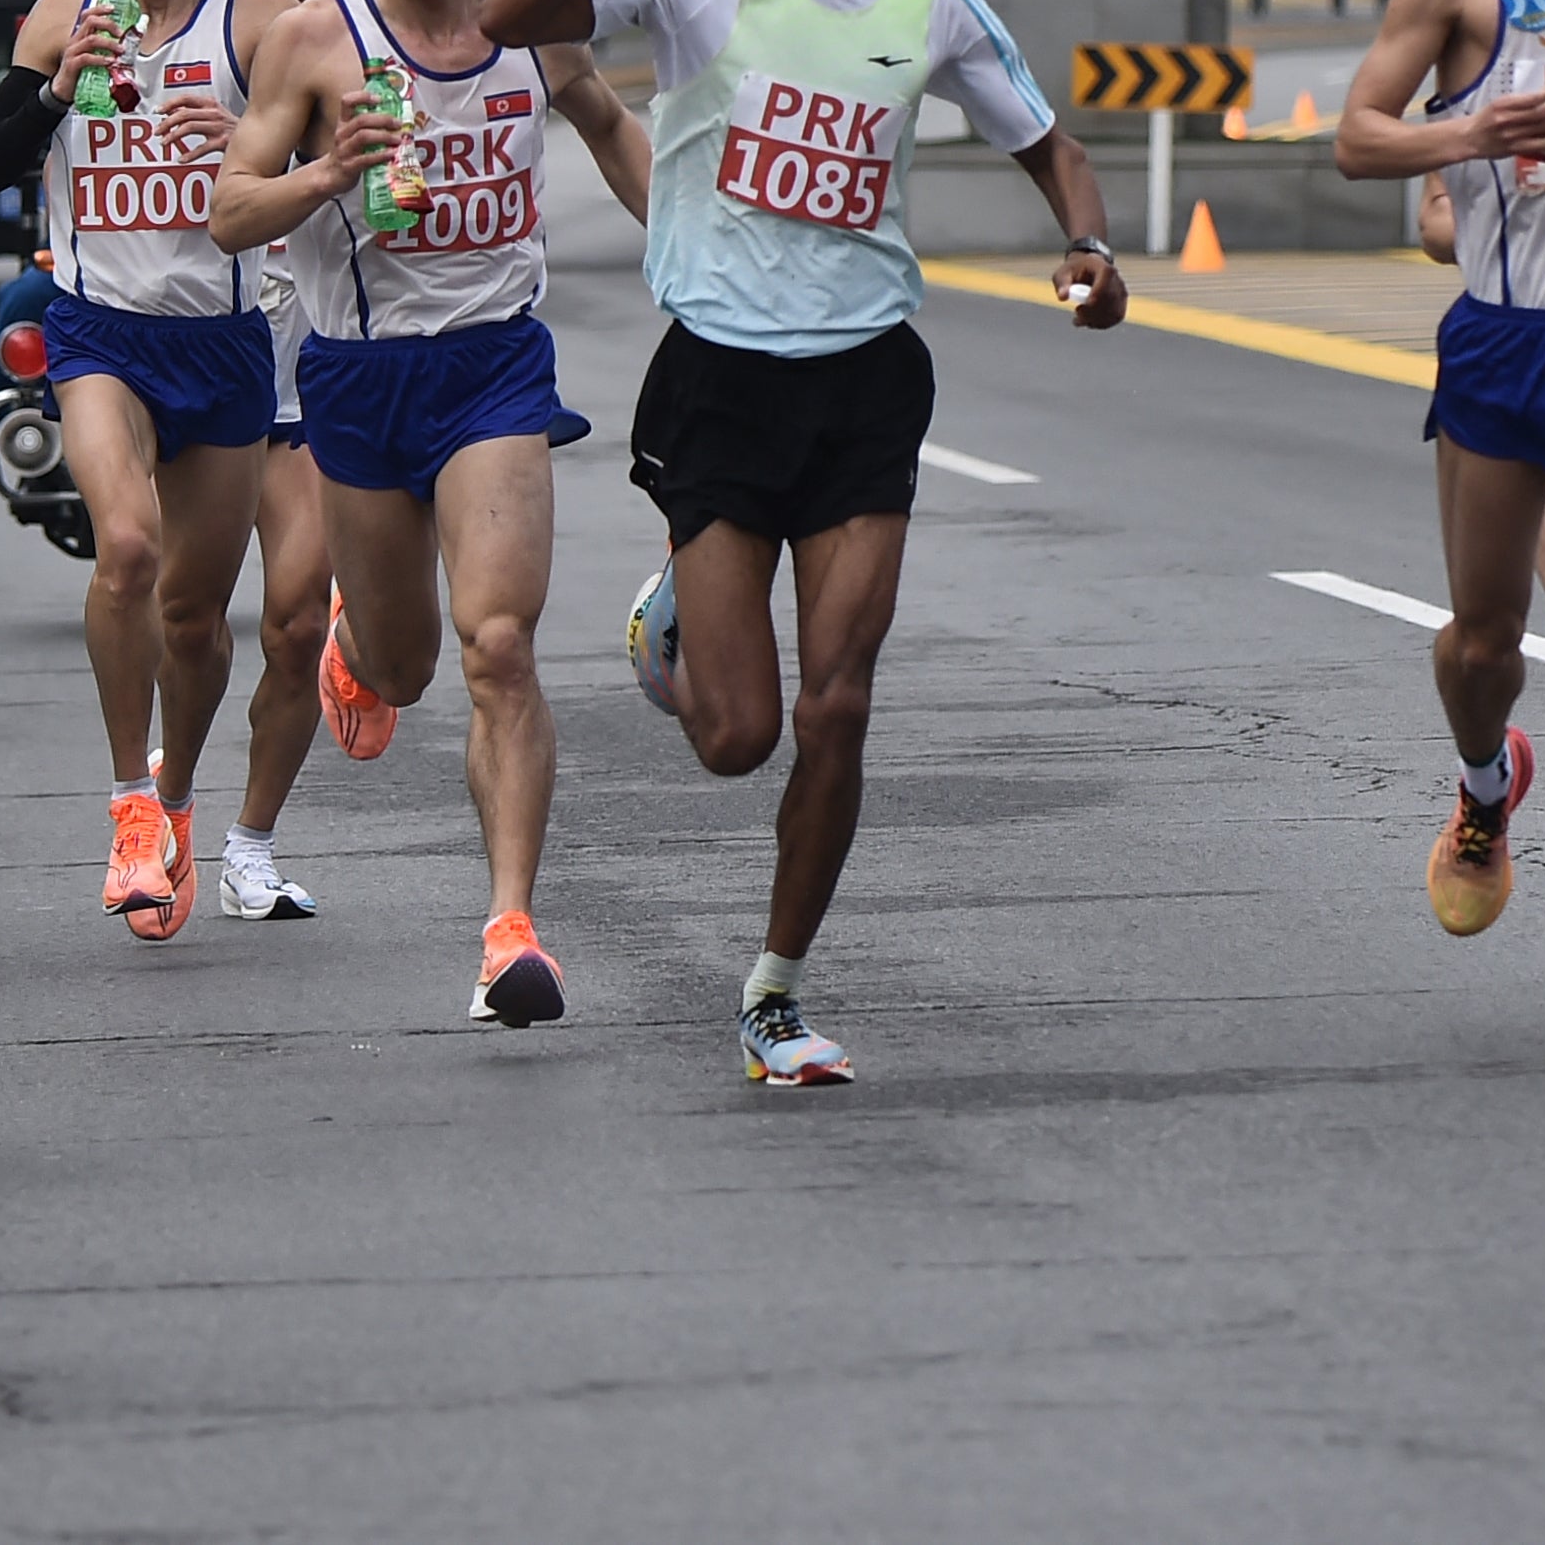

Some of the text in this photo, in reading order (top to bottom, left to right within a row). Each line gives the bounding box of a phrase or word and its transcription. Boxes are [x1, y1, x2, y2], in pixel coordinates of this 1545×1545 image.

[760, 81, 890, 154] PRK
[79, 170, 214, 226] 1000
[726, 138, 880, 225] 1085
